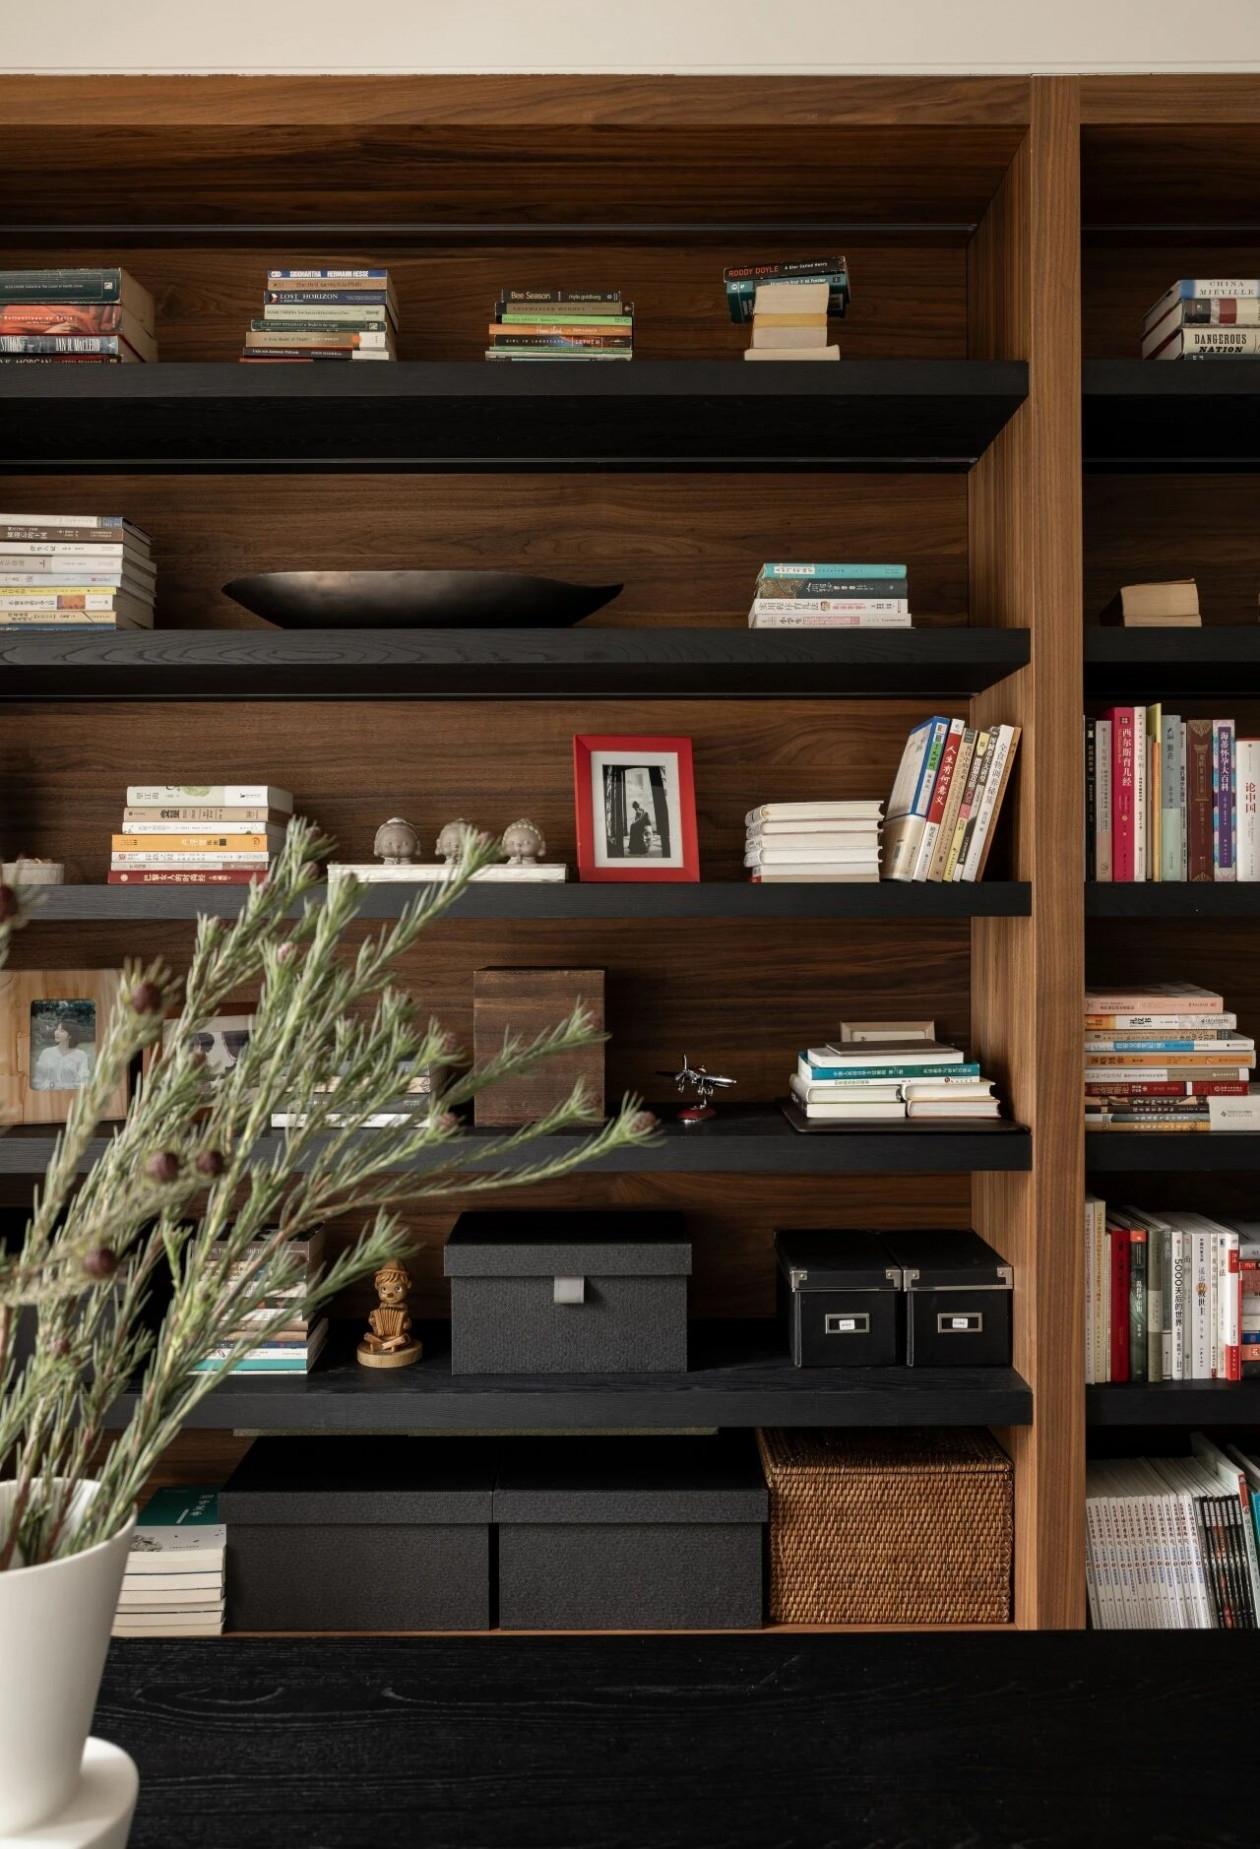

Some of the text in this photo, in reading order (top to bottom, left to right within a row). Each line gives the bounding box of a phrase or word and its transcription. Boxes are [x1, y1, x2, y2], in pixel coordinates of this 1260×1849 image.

[755, 265, 780, 274] DOYLE
[511, 291, 551, 300] Bee Season
[1194, 333, 1247, 345] DANGEROUS
[1121, 728, 1132, 787] 西尔斯育儿经
[1220, 731, 1229, 792] 海蒂怀孕大百科
[1245, 781, 1257, 814] 论中国
[1174, 1258, 1184, 1326] 5000天后的世界
